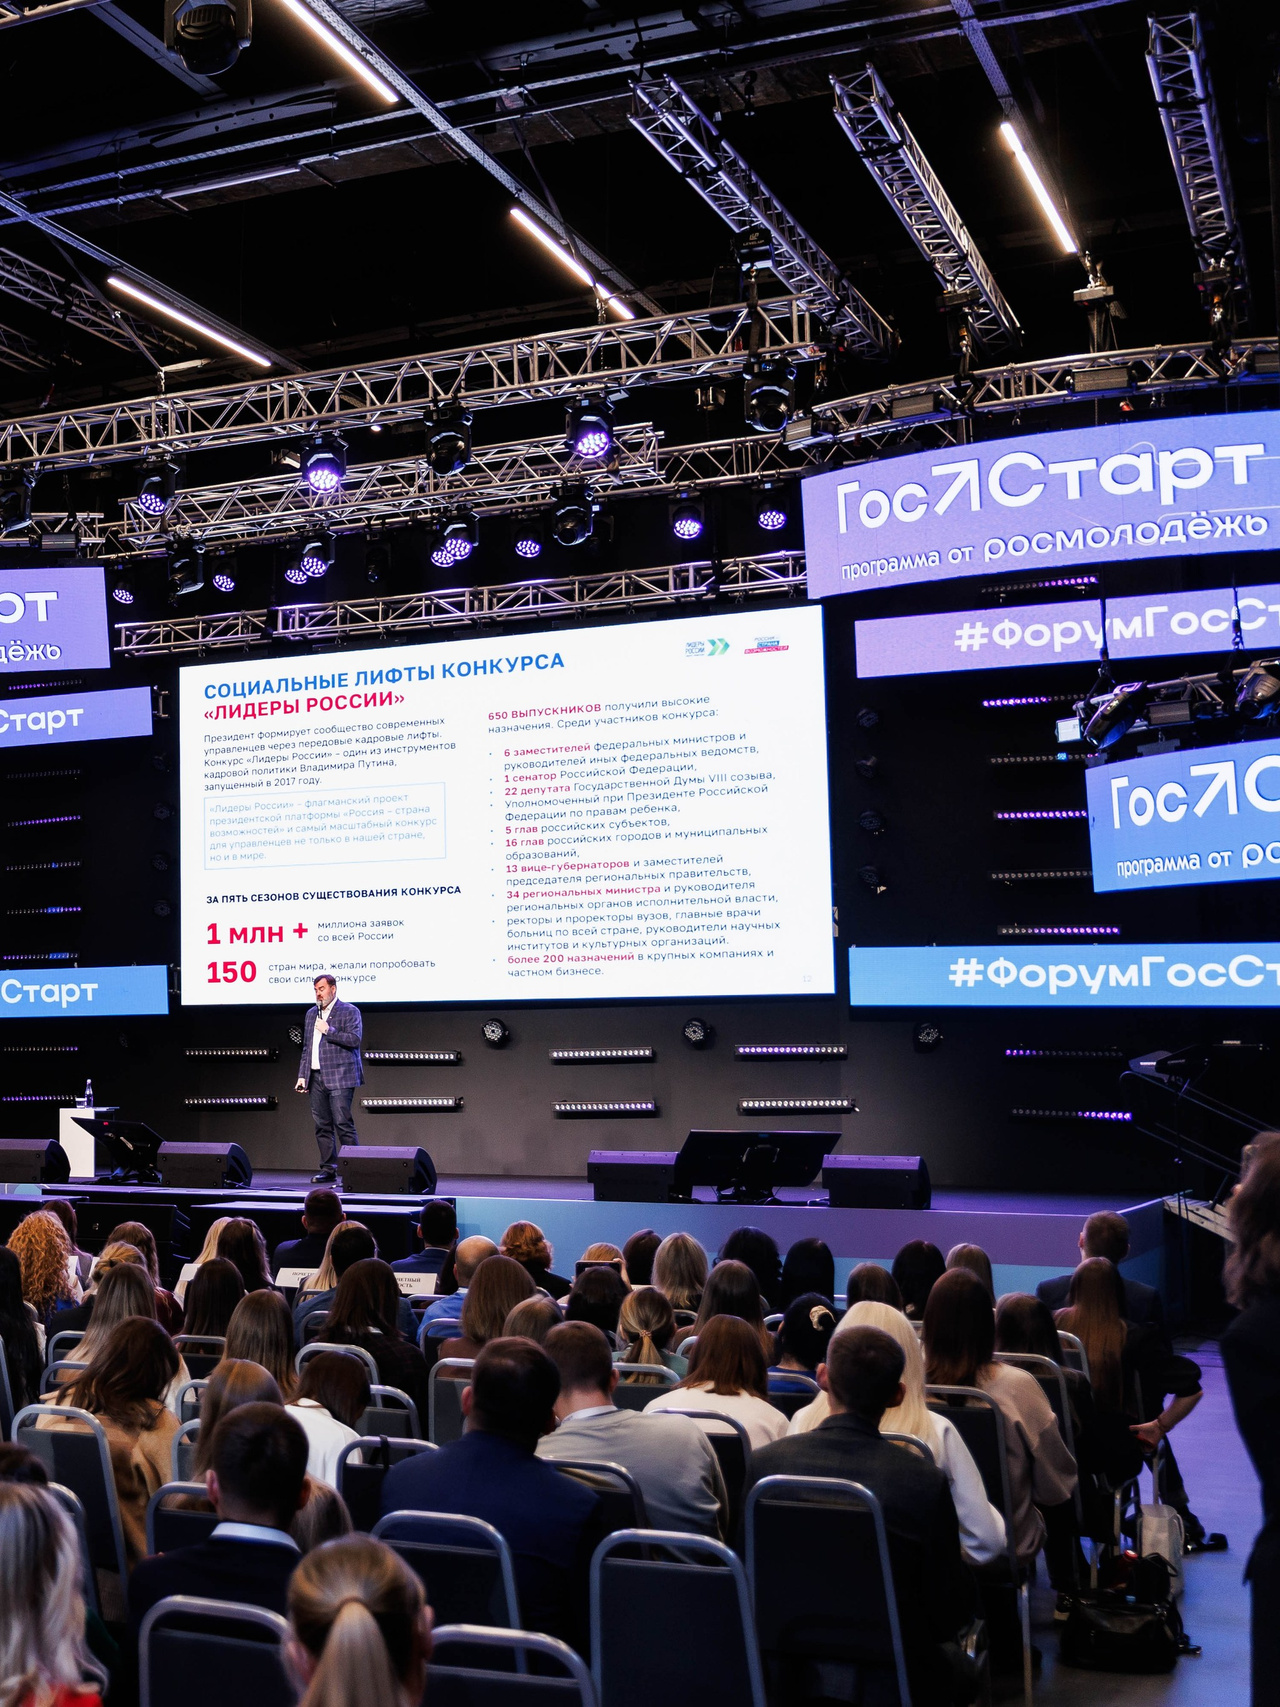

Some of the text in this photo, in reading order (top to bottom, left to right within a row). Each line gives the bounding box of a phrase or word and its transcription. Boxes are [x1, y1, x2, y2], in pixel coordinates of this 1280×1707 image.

[841, 512, 1269, 583] программа от росмолодёжь
[204, 652, 565, 699] СОЦИАЛЬНЫЕ ЛИФТЫ КОНКУРСА
[204, 691, 405, 720] «ЛИДЕРЫ РОССИИ»
[488, 696, 710, 721] 650 ВЫПУСКНИКОВ получили высокие
[204, 718, 445, 744] Президент формирует сообщество современных
[488, 709, 718, 734] назначения. Среди участников конкурса:
[204, 731, 442, 757] управленцев через передовые кадровые лифты.
[513, 733, 736, 757] заместителей федеральных министров
[204, 742, 456, 767] Конкурс «Лидеры России» один инструментов
[504, 746, 759, 772] руководителей иных федеральных ведомств,
[204, 759, 397, 780] кадровой политики Владимира Путина,
[512, 764, 697, 782] сенатор Российской Федерации,
[204, 777, 322, 792] запущенный 2017 году.
[504, 772, 776, 796] 22 депутата Государственной Думы VIII созыва,
[505, 783, 768, 809] Уполномоченный при Президенте Российской
[505, 804, 680, 822] Федерации правам ребенка,
[515, 819, 670, 834] глав российских субъектов,
[506, 827, 768, 847] 16 глав российских городов муниципальных
[505, 848, 580, 862] образований,
[506, 854, 723, 873] 13 вице-губернаторов заместителей
[1116, 854, 1200, 880] программа
[1207, 851, 1232, 868] от
[506, 868, 751, 887] председателя региональных правительств,
[206, 885, 461, 904] ЗА ПЯТЬ СЕЗОНОВ СУЩЕСТВОВАНИЯ КОНКУРСА
[506, 882, 755, 900] 34 региональных министра руководителя
[507, 894, 778, 914] региональных органов исполнительной власти,
[317, 919, 404, 929] миллиона заявок
[507, 909, 761, 927] ректоры проректоры вузов, главные врачи
[207, 923, 221, 945] 1
[229, 926, 283, 944] млн
[332, 932, 394, 942] всей России
[507, 922, 780, 938] больниц всей стране, руководители научных
[507, 935, 729, 952] институтов культурных организаций.
[268, 959, 436, 973] стран мира, желали попробовать
[507, 950, 763, 964] более 200 назначений крупных компаниях
[207, 960, 257, 983] 150
[335, 974, 377, 984] онкурсе
[507, 967, 604, 977] частном бизнесе.
